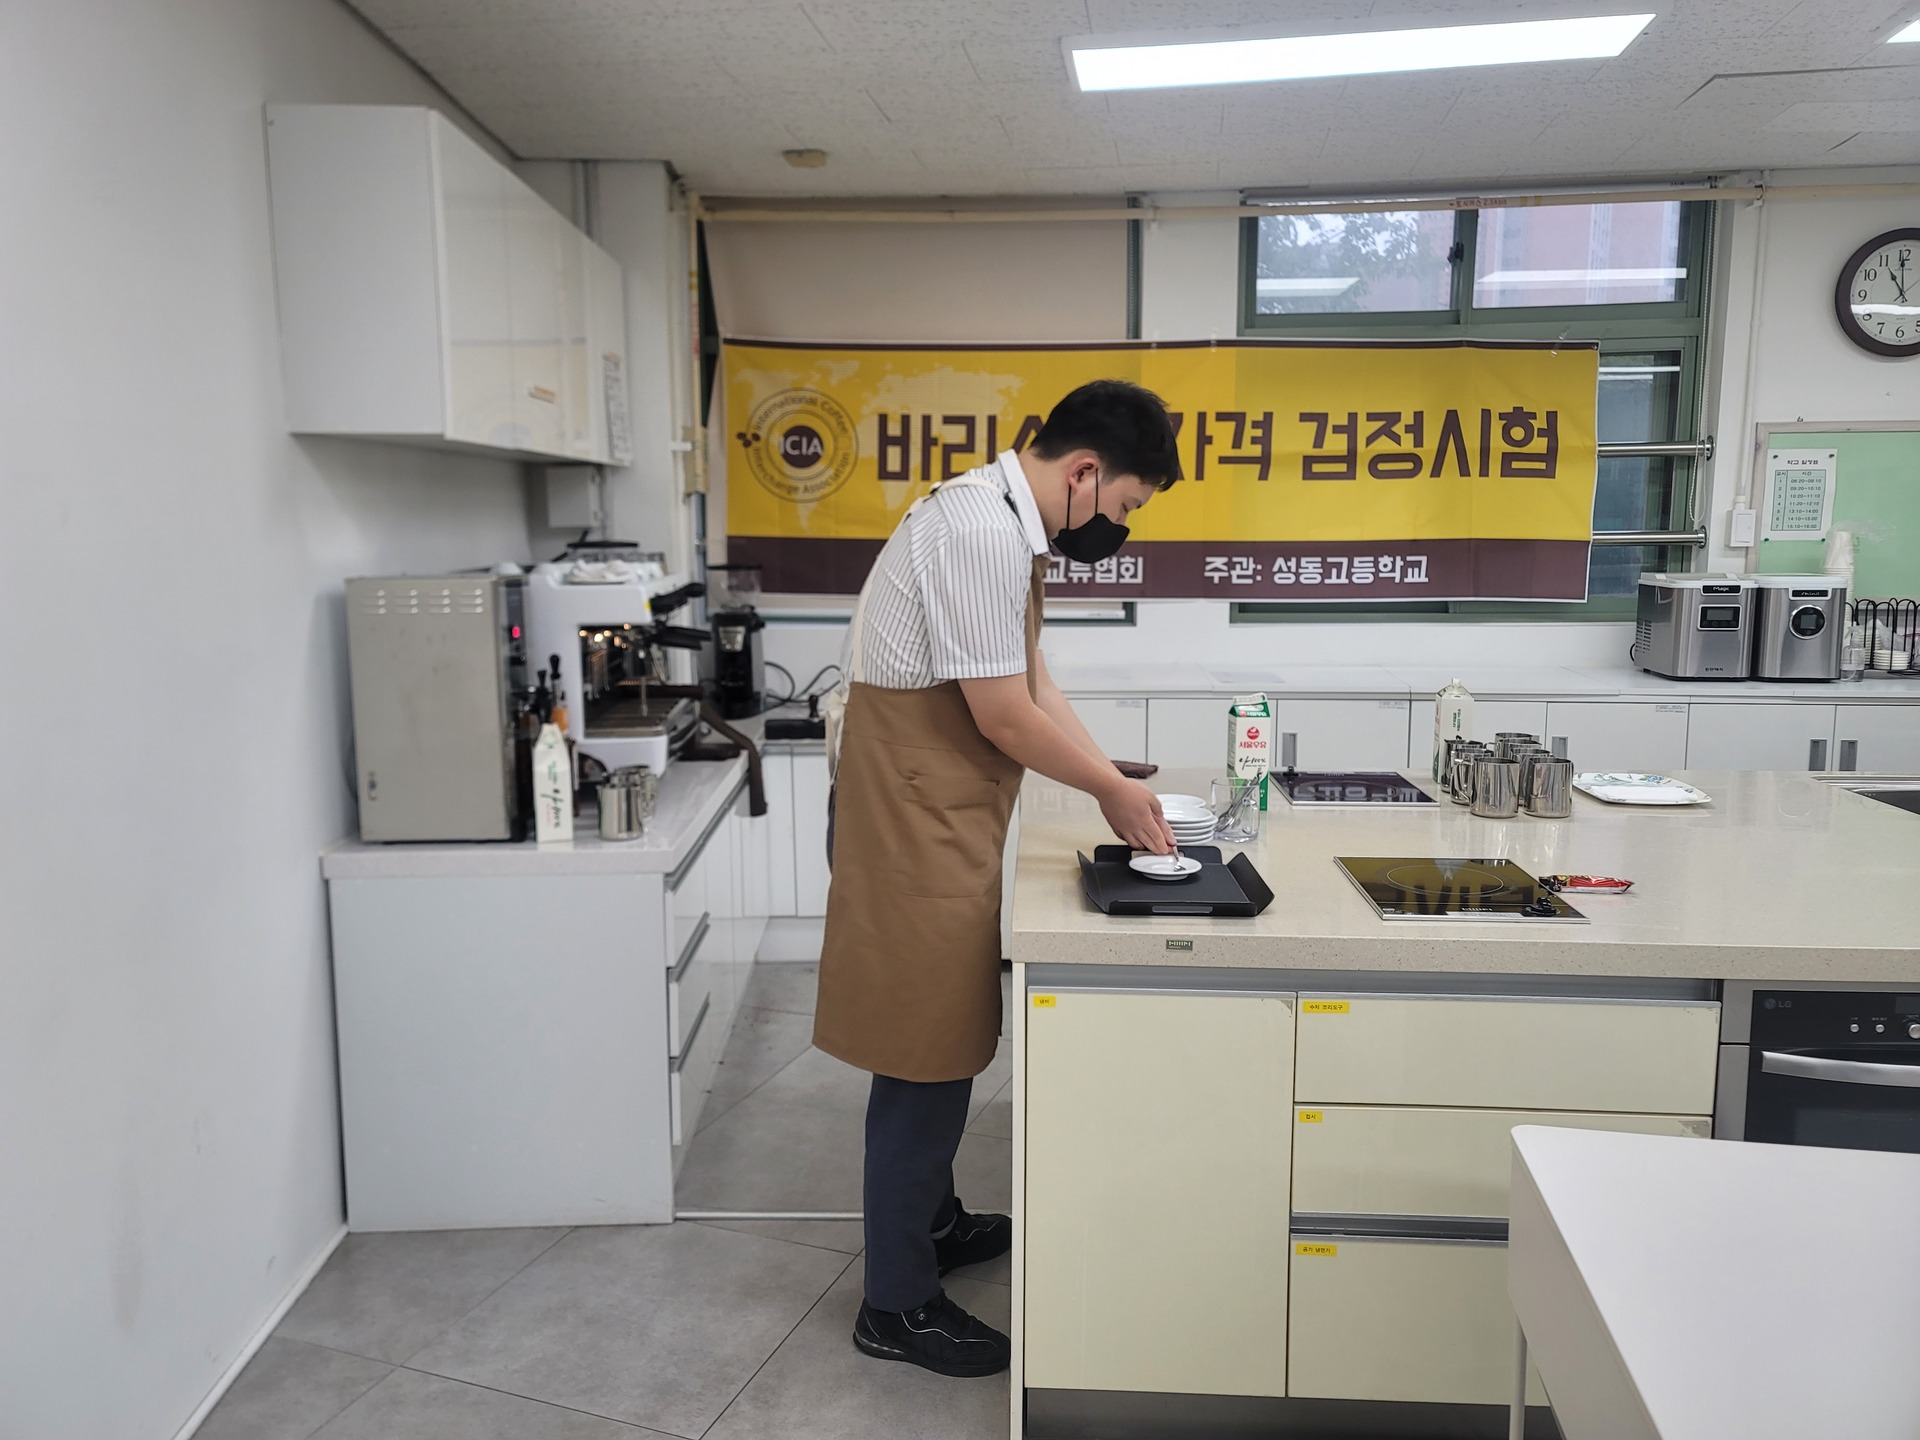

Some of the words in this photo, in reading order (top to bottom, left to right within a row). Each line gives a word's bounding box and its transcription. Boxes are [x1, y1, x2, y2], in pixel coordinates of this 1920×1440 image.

[1879, 254, 1889, 267] 11
[1898, 249, 1911, 262] 12
[1863, 268, 1877, 281] 10
[1858, 289, 1868, 302] 9
[1876, 322, 1885, 334] 7
[1895, 326, 1905, 338] 6
[779, 435, 824, 456] ICIA
[1299, 406, 1559, 481] 검정시험
[1204, 556, 1263, 585] 주관:
[1271, 555, 1429, 585] 성동고등학교
[1778, 1000, 1792, 1008] LG
